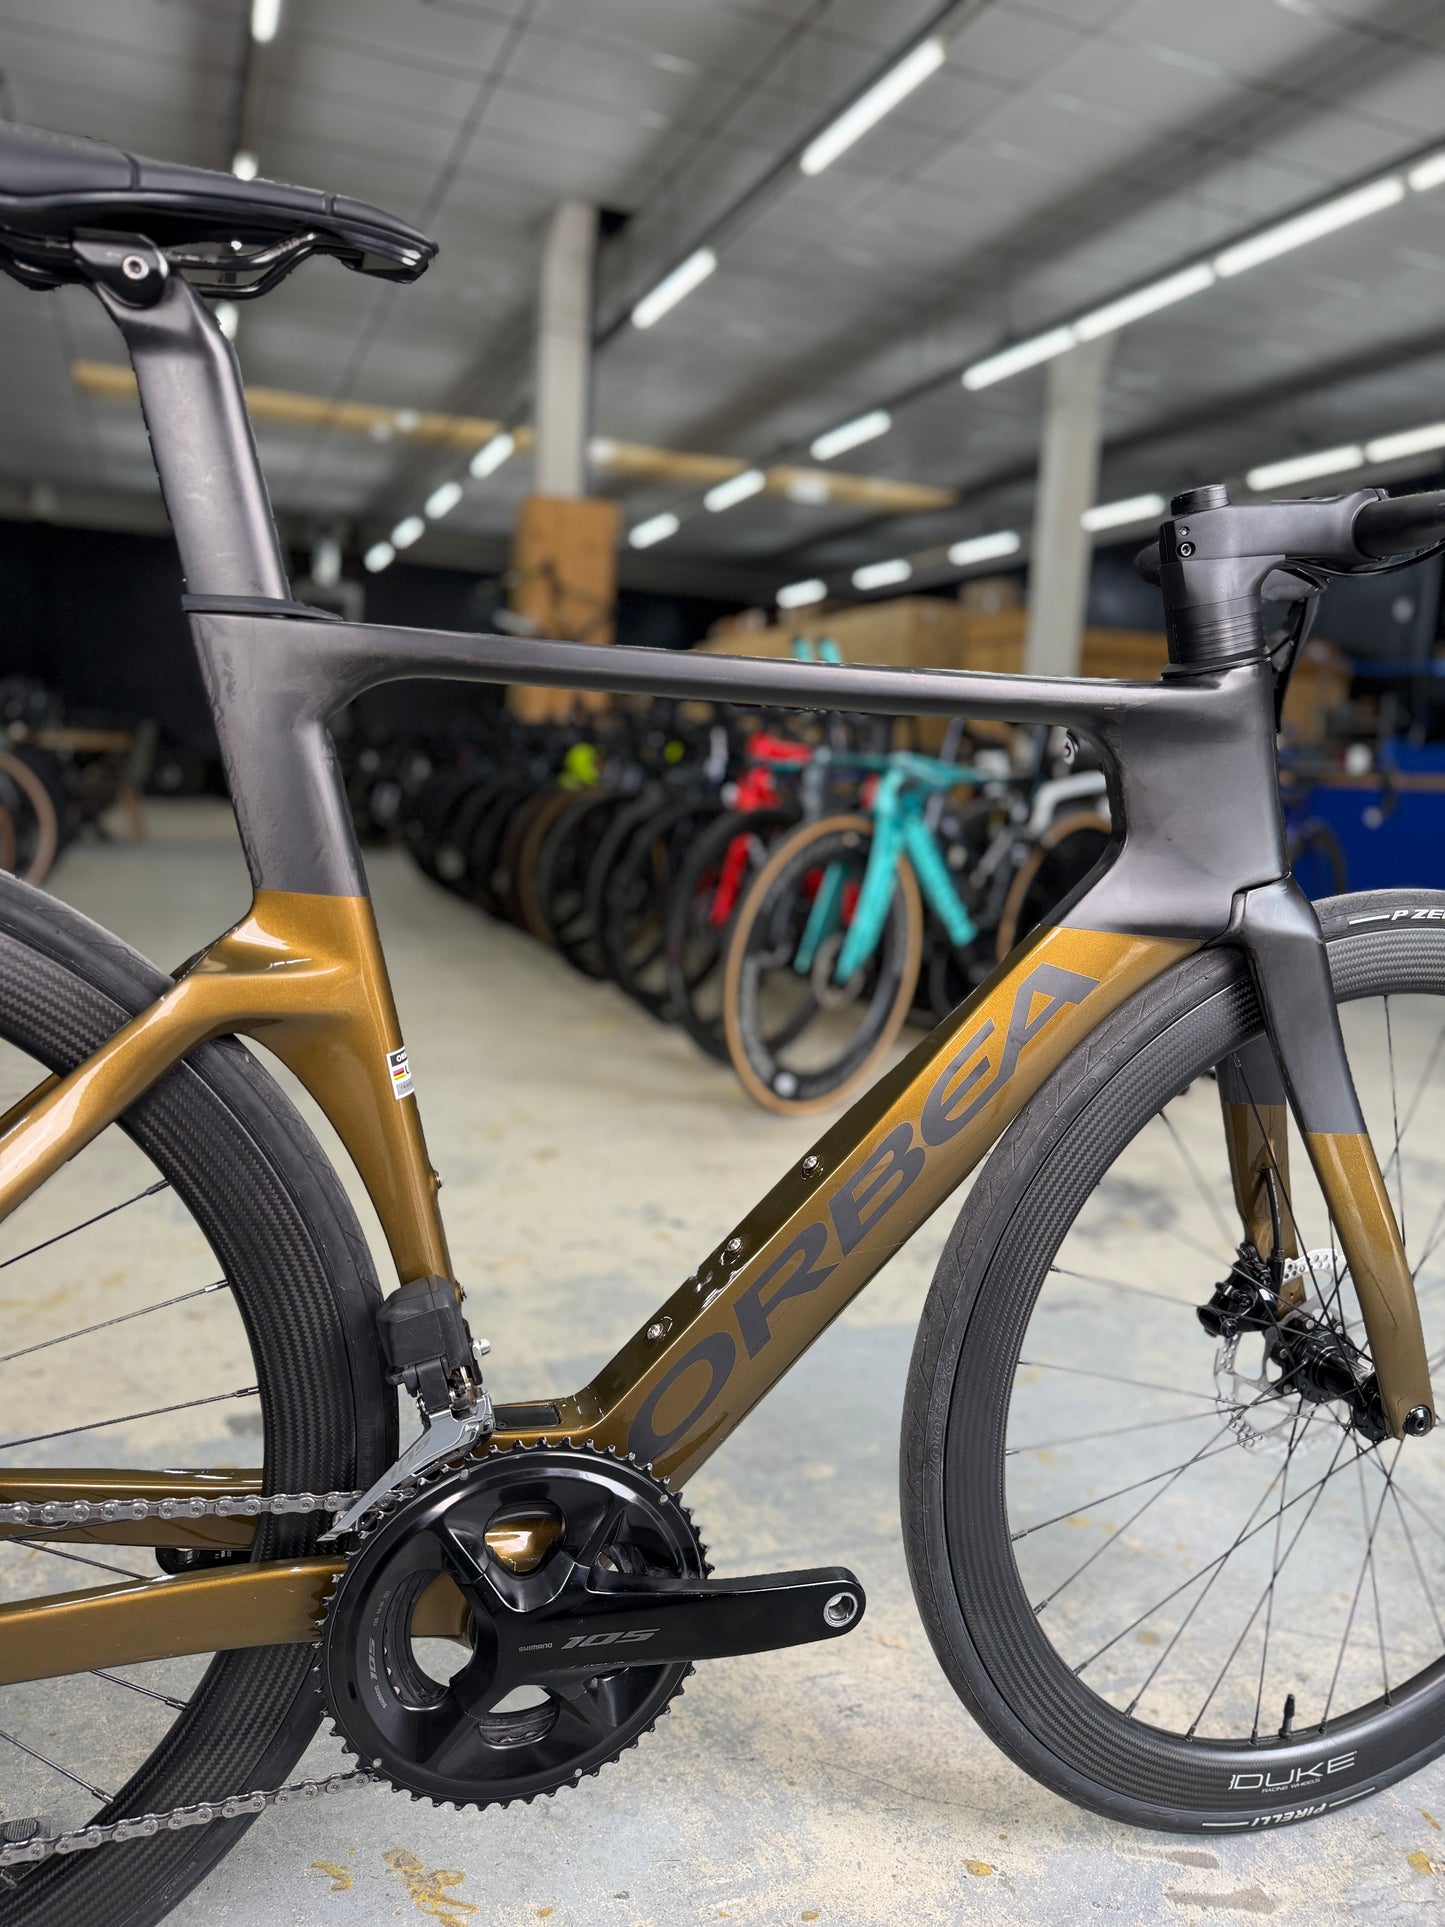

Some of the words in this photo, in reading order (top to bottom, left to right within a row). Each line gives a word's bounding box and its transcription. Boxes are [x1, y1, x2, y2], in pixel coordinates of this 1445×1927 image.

[1390, 909, 1409, 921] P
[1410, 908, 1445, 920] ZE
[627, 962, 1101, 1463] ORBEA
[518, 1642, 553, 1653] SHIMANO
[560, 1628, 661, 1650] 105
[368, 1636, 378, 1680] 105
[1230, 1750, 1358, 1791] DUKE
[1261, 1785, 1289, 1794] RACING
[1290, 1777, 1321, 1790] WHEELS
[1251, 1803, 1326, 1827] PIRELLI
